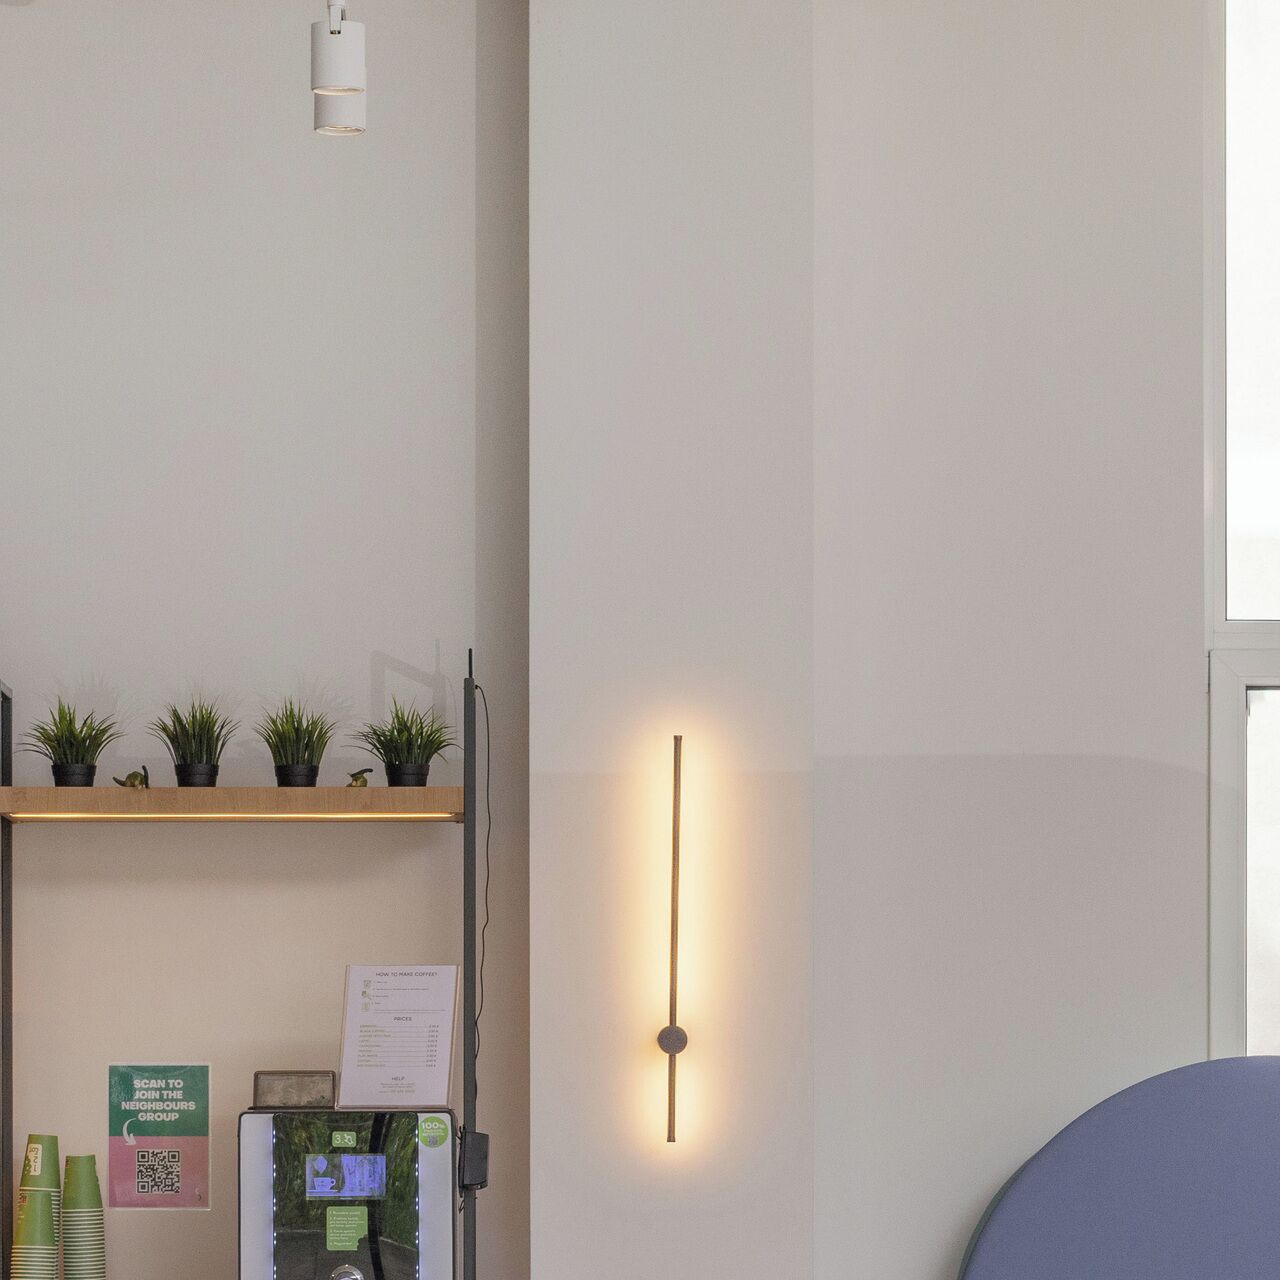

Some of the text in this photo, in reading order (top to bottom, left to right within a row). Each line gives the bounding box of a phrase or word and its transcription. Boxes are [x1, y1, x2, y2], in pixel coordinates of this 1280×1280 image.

[133, 1079, 183, 1088] SCAN TO
[133, 1090, 183, 1099] JOIN THE
[121, 1101, 196, 1110] NEIGHBOURS
[137, 1112, 179, 1121] GROUP
